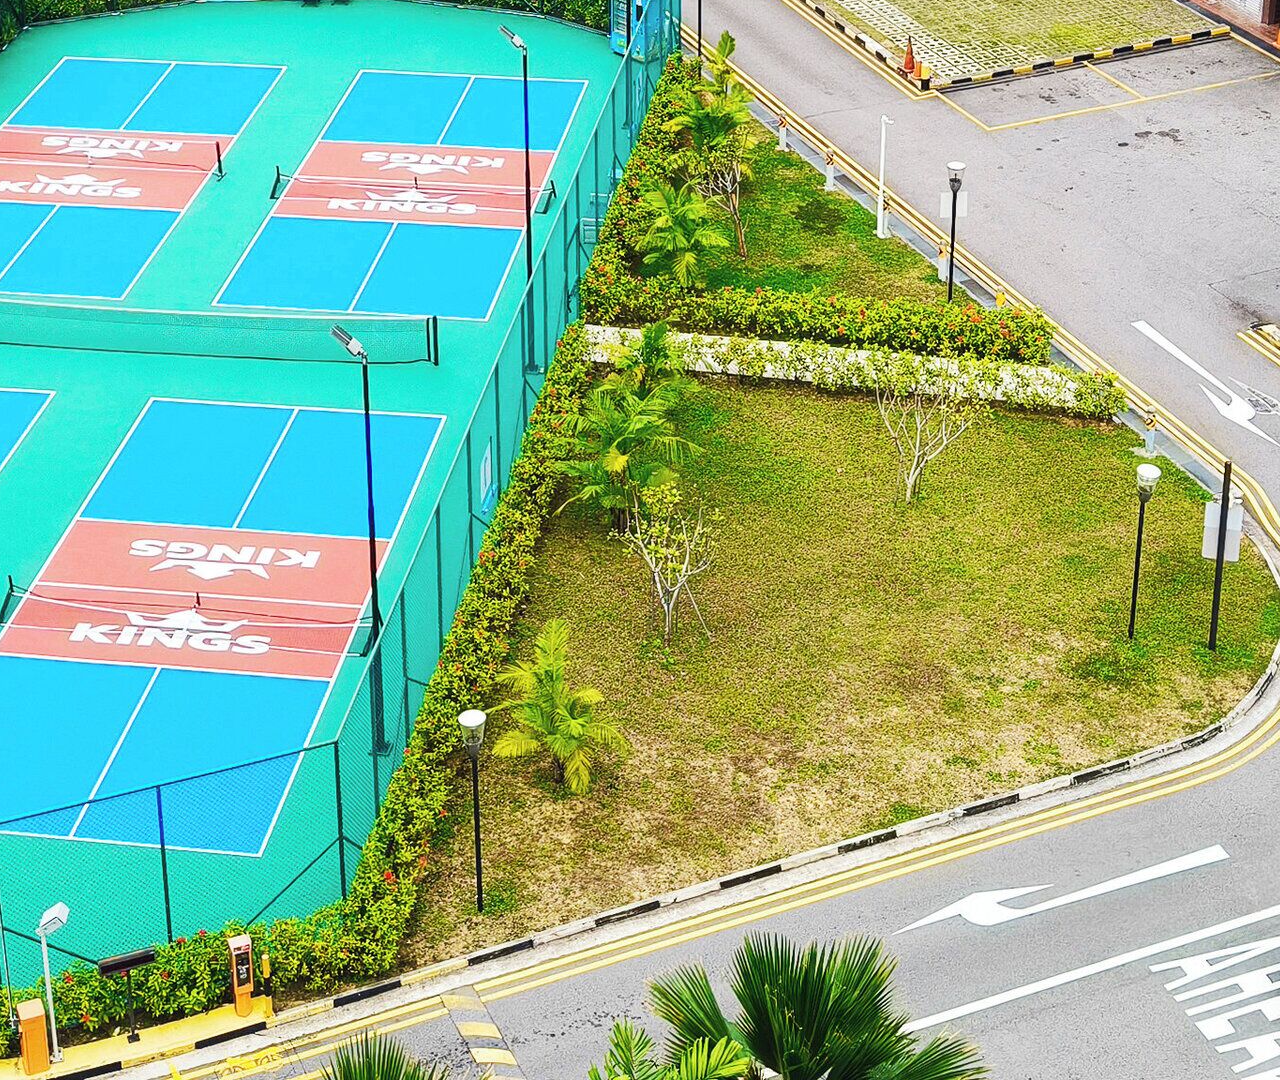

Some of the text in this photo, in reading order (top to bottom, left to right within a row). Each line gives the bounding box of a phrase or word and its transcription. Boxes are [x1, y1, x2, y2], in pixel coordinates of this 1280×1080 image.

[40, 135, 184, 153] KINGS
[360, 151, 506, 169] KINGS
[327, 198, 477, 216] KINGS
[128, 539, 321, 569] KINGS
[69, 622, 271, 655] KINGS
